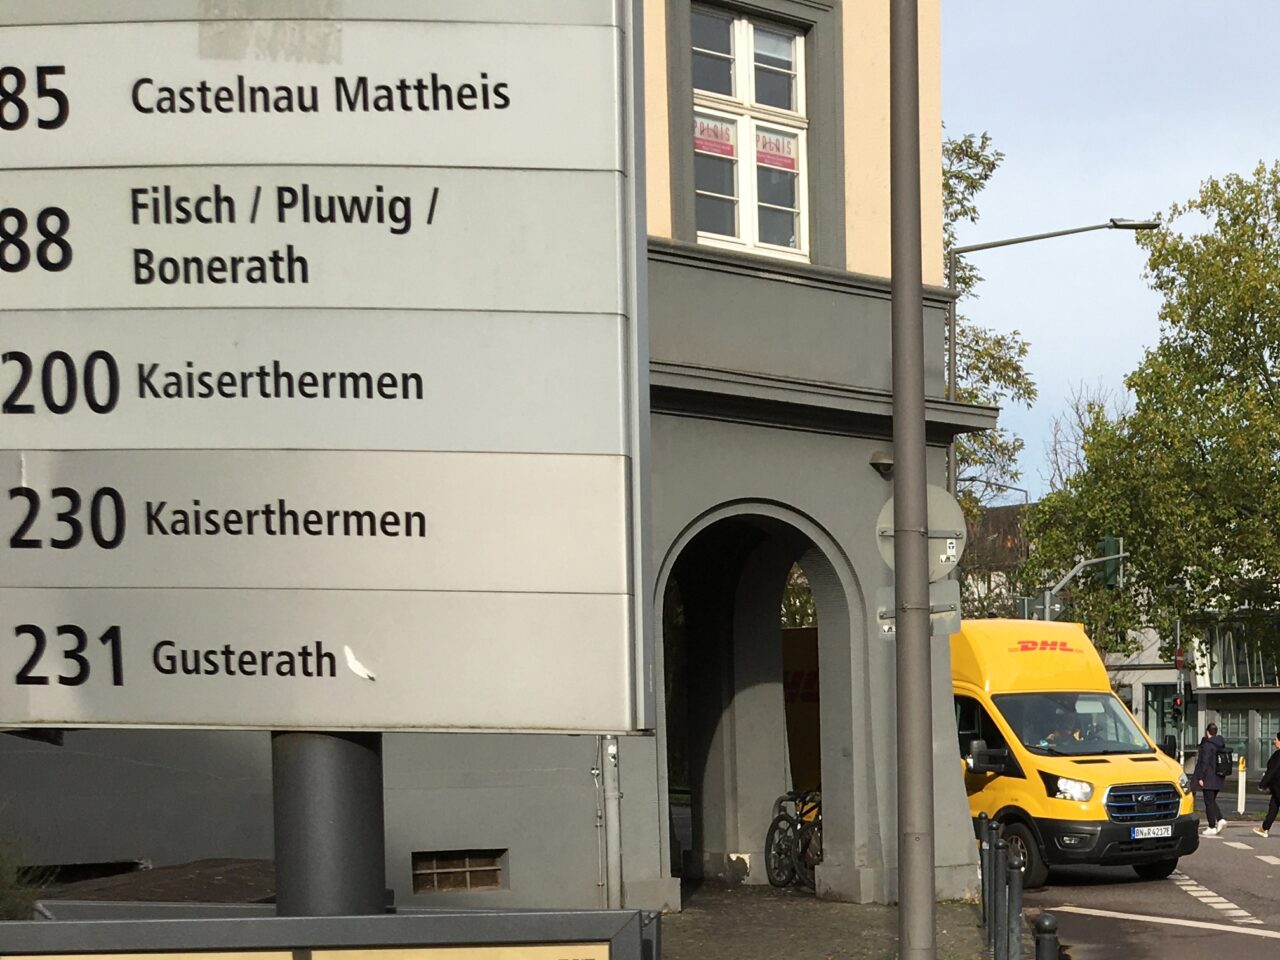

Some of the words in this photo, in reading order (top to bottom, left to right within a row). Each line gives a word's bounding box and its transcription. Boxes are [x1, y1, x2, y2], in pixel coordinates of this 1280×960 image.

[0, 65, 70, 131] 85
[131, 75, 319, 114] Castelnau
[335, 72, 511, 112] Mattheis
[0, 206, 73, 273] 88
[131, 184, 236, 225] Filsch
[250, 186, 262, 225] /
[277, 183, 412, 235] Pluwig
[426, 187, 439, 225] /
[133, 244, 309, 285] Bonerath
[1, 350, 121, 415] 200
[137, 360, 424, 400] Kaiserthermen
[8, 486, 126, 550] 230
[145, 498, 427, 538] Kaiserthermen
[14, 624, 125, 687] 231
[152, 640, 337, 677] Gusterath
[1017, 640, 1074, 652] DHL
